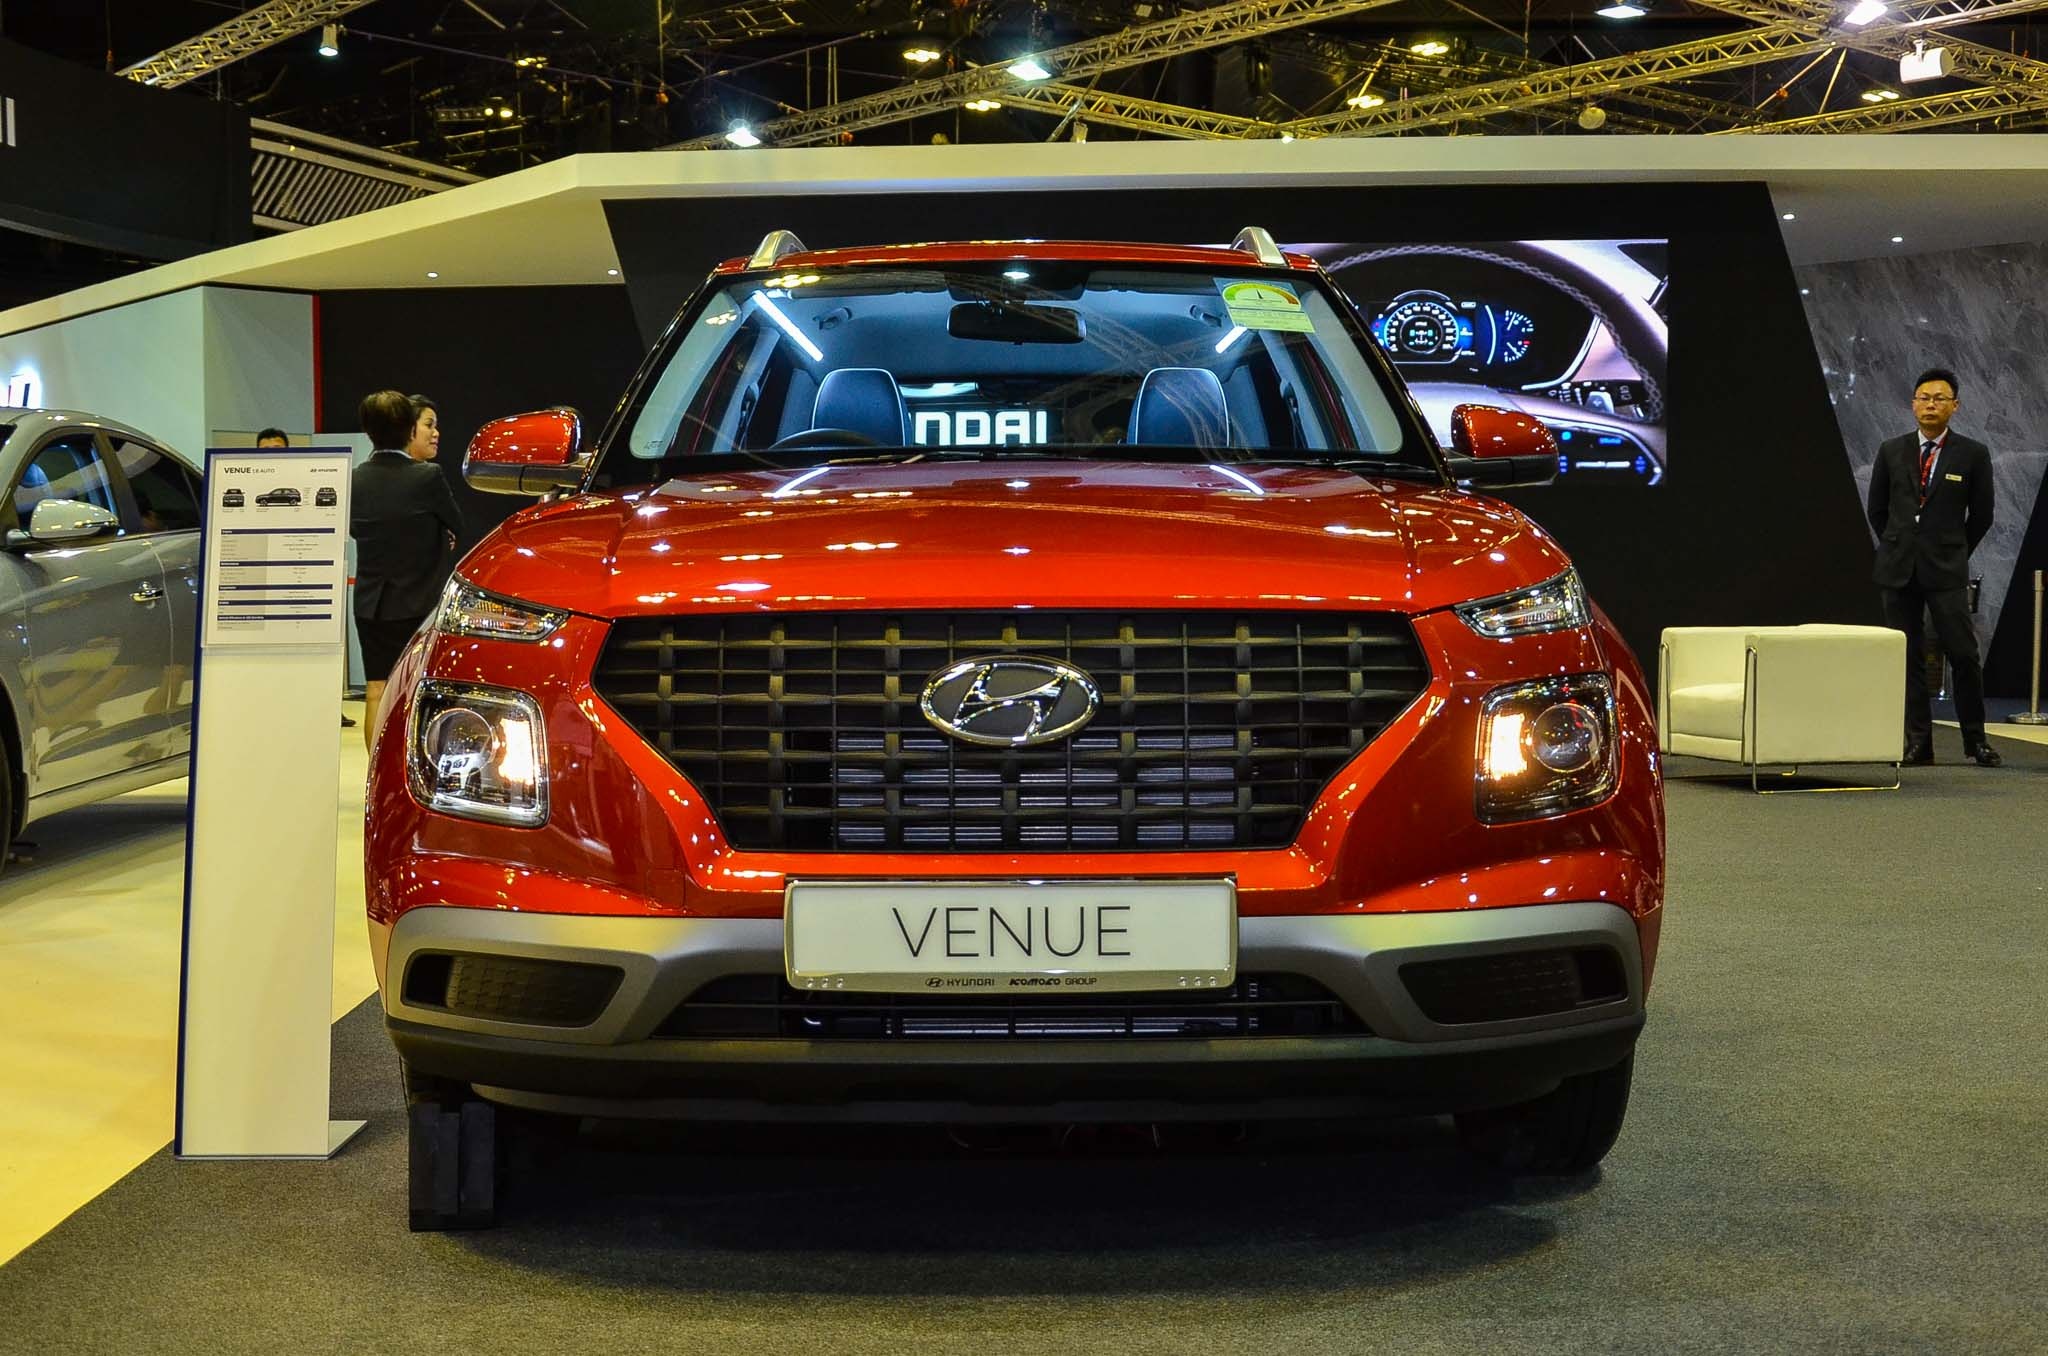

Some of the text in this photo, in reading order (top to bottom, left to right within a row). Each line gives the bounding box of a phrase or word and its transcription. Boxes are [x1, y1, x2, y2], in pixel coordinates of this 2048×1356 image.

[892, 906, 1131, 958] VENUE
[946, 978, 995, 986] HYUNDAI
[1065, 977, 1097, 986] GROUP
